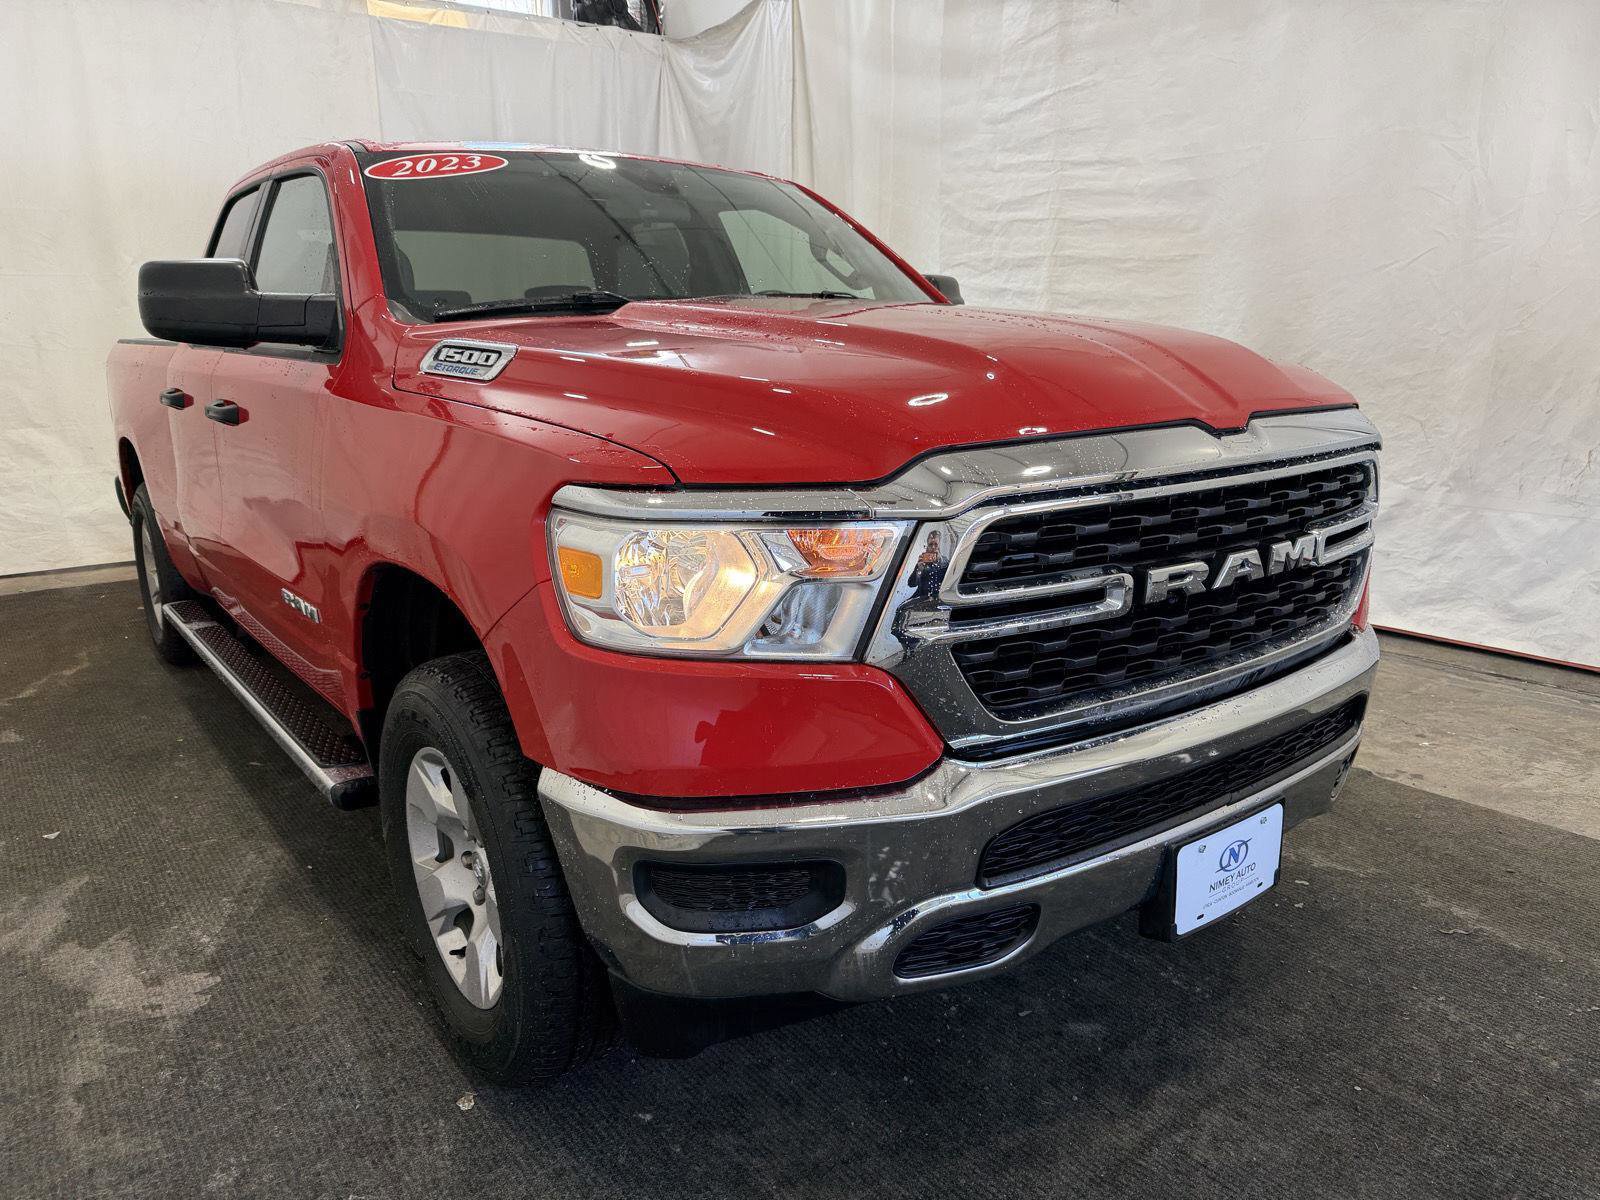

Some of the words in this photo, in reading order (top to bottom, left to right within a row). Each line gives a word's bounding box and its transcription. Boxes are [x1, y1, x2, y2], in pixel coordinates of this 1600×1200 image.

[391, 155, 482, 177] 2023
[437, 346, 500, 367] 1500
[1145, 533, 1316, 604] RAM
[1208, 872, 1236, 893] NIMEY
[1235, 862, 1257, 880] AUTO
